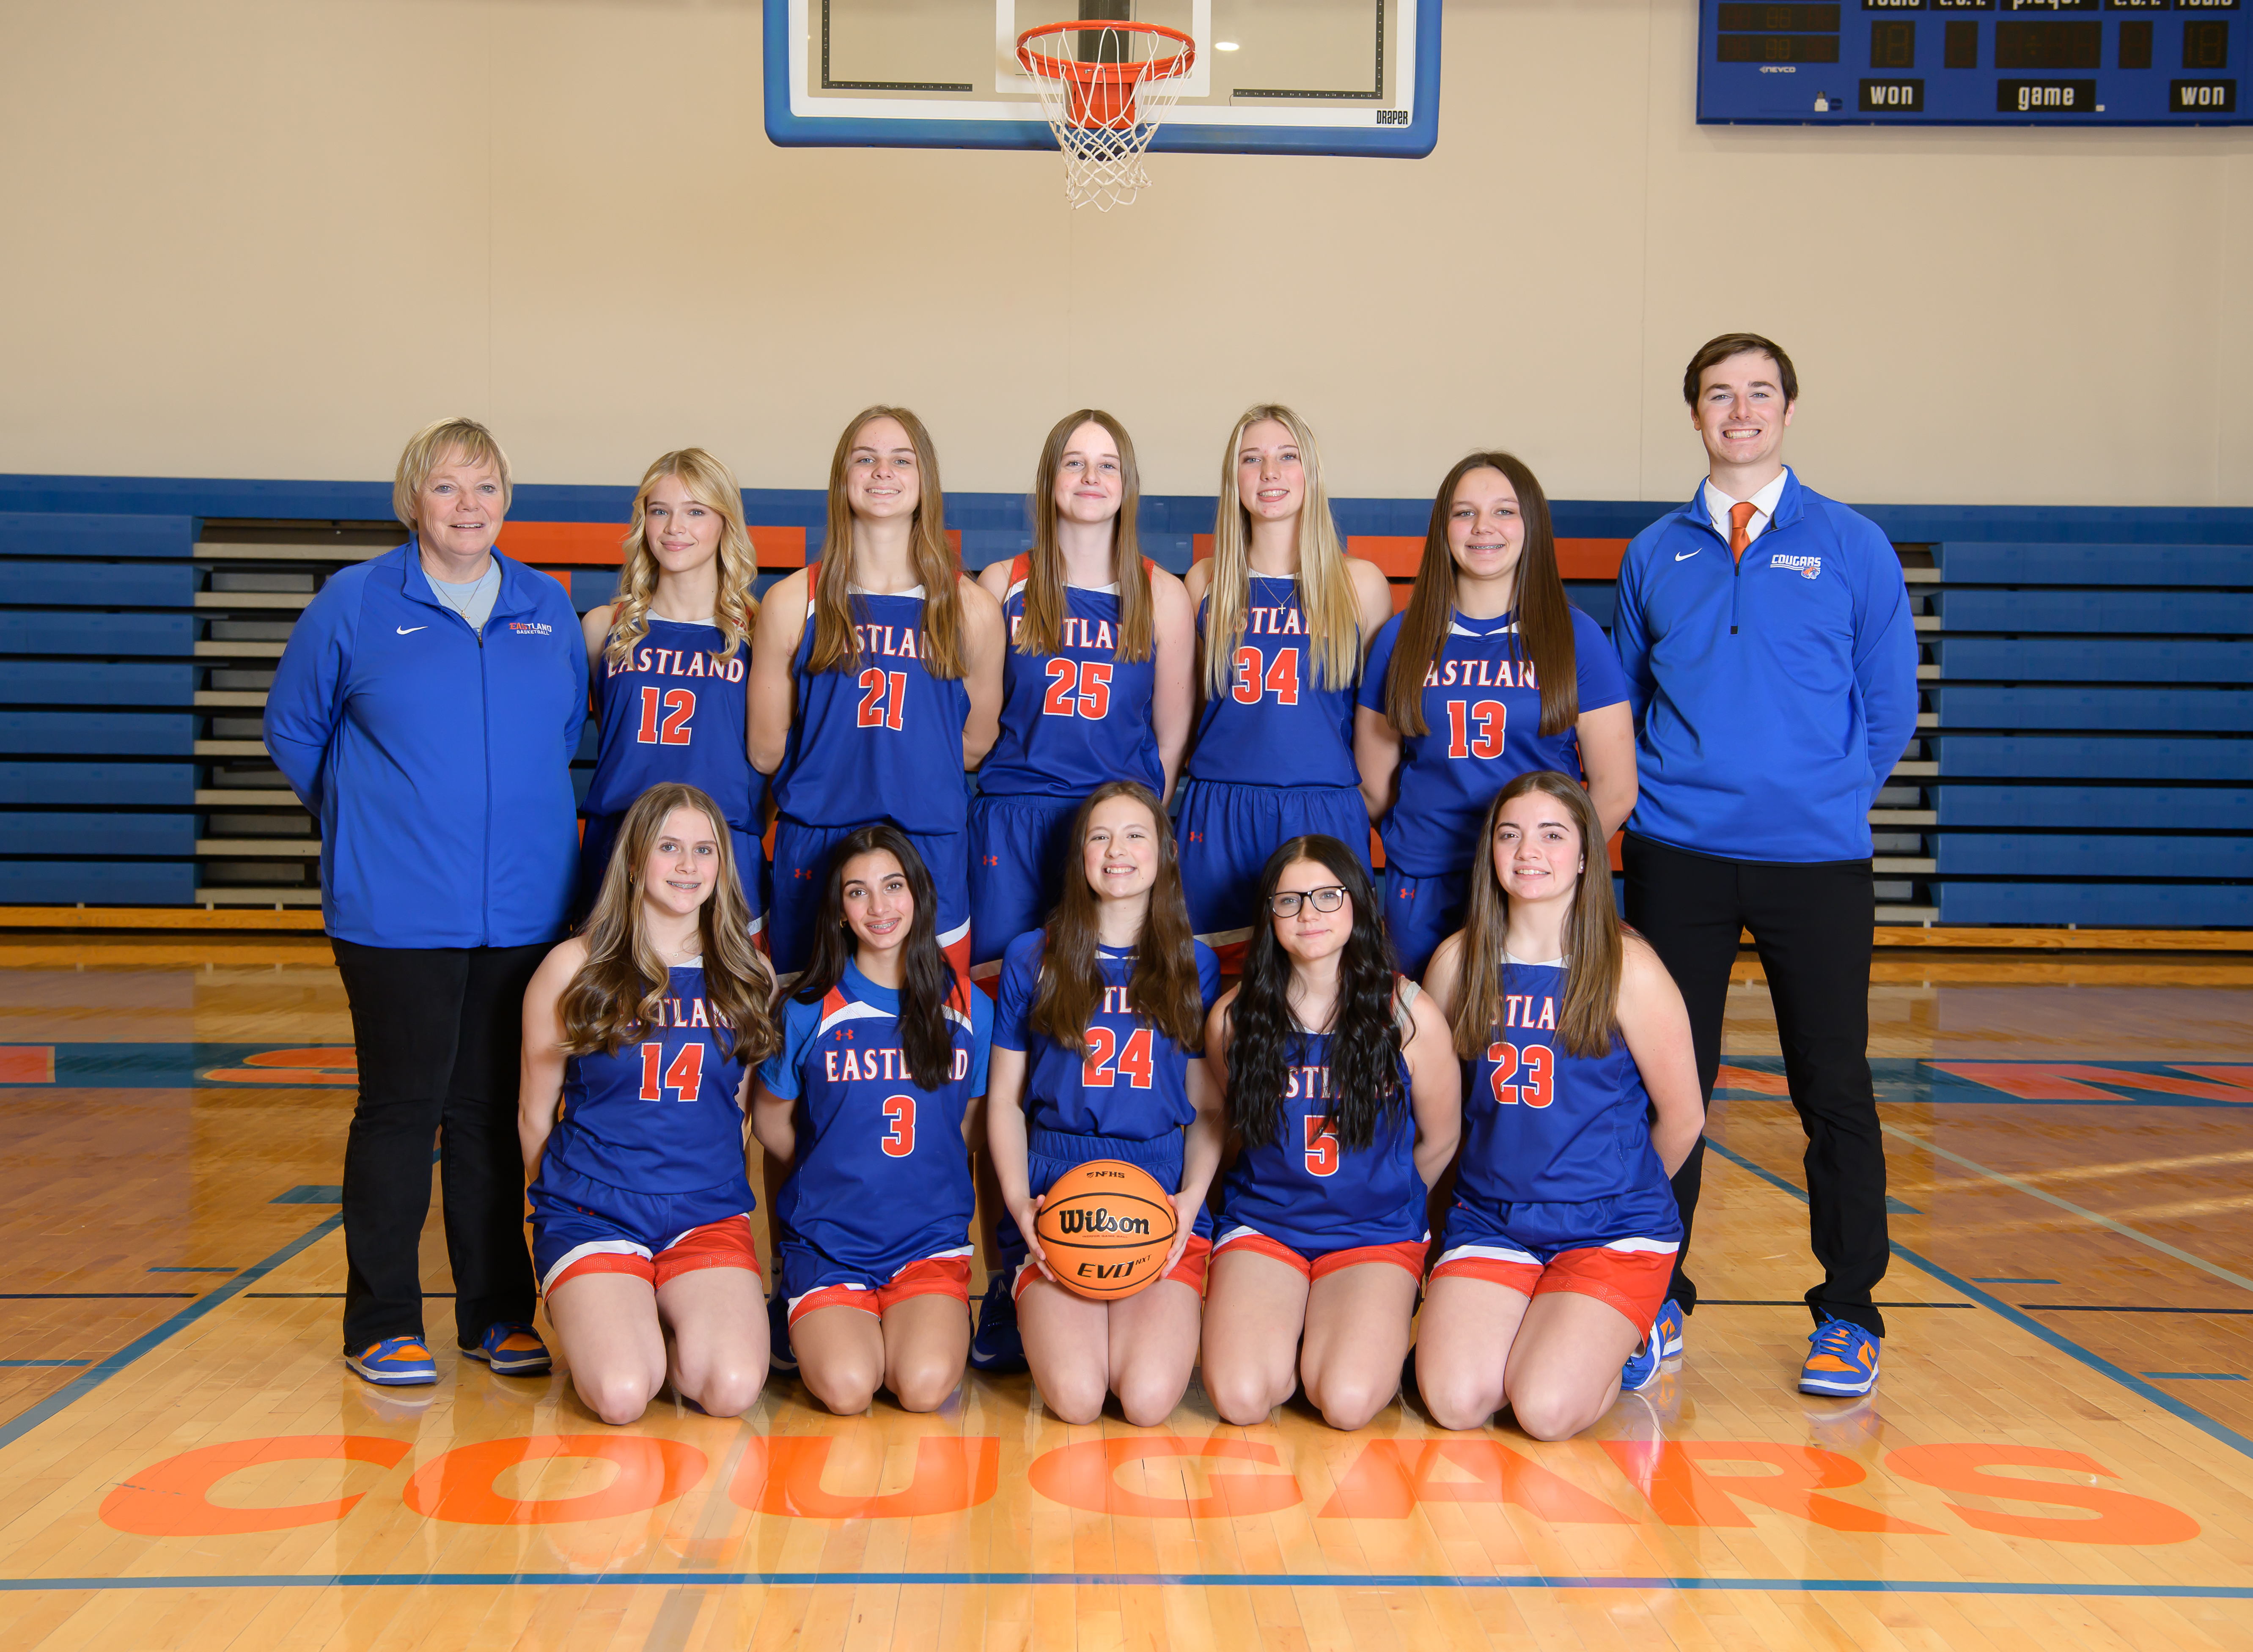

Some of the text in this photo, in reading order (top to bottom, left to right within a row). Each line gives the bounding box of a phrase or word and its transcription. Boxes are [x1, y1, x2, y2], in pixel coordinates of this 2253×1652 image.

[1870, 86, 1913, 104] won
[2018, 86, 2074, 111] game
[2181, 86, 2224, 105] won
[1771, 554, 1822, 567] COUGARS
[509, 622, 552, 632] EASTLAND
[857, 667, 907, 731] 21
[1043, 657, 1113, 721] 25
[1232, 646, 1299, 705] 34
[1423, 660, 1540, 690] ASTLAN
[637, 686, 696, 746] 12
[1447, 700, 1507, 760] 13
[639, 1042, 704, 1102] 14
[825, 1048, 968, 1082] EASTLD
[1082, 1026, 1154, 1089] 24
[1487, 1041, 1554, 1109] 23
[881, 1095, 916, 1158] 3
[1304, 1115, 1339, 1177] 5
[1059, 1207, 1151, 1235] Wilson
[1077, 1254, 1152, 1279] EVO NXT
[98, 1434, 2201, 1546] COUGARS
